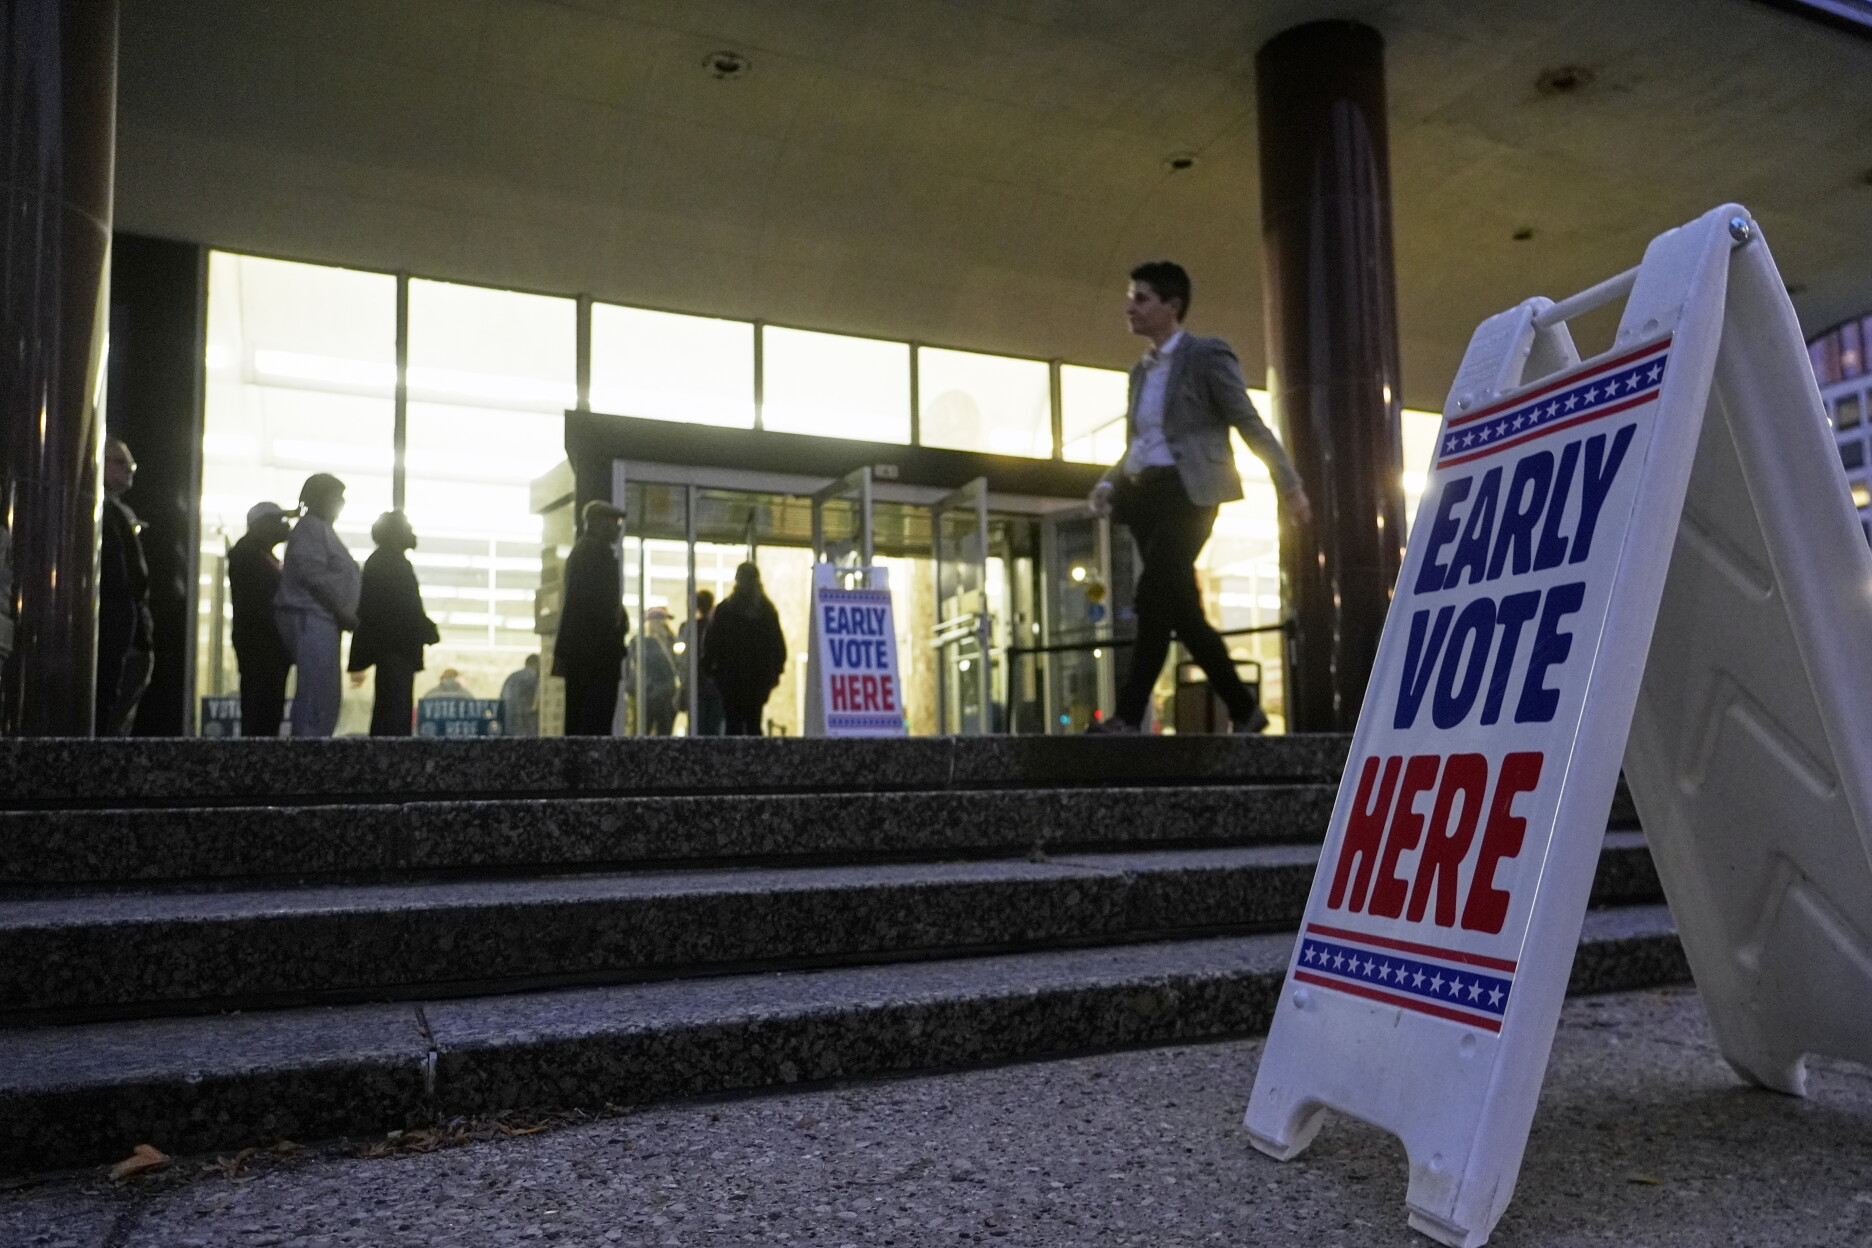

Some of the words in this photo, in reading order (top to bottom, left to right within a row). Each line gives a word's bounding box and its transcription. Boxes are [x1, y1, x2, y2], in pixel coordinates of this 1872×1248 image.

[1413, 423, 1637, 595] EARLY
[823, 605, 886, 636] EARLY
[828, 638, 889, 669] VOTE
[1393, 581, 1586, 730] VOTE
[830, 674, 895, 711] HERE
[1327, 751, 1544, 935] HERE
